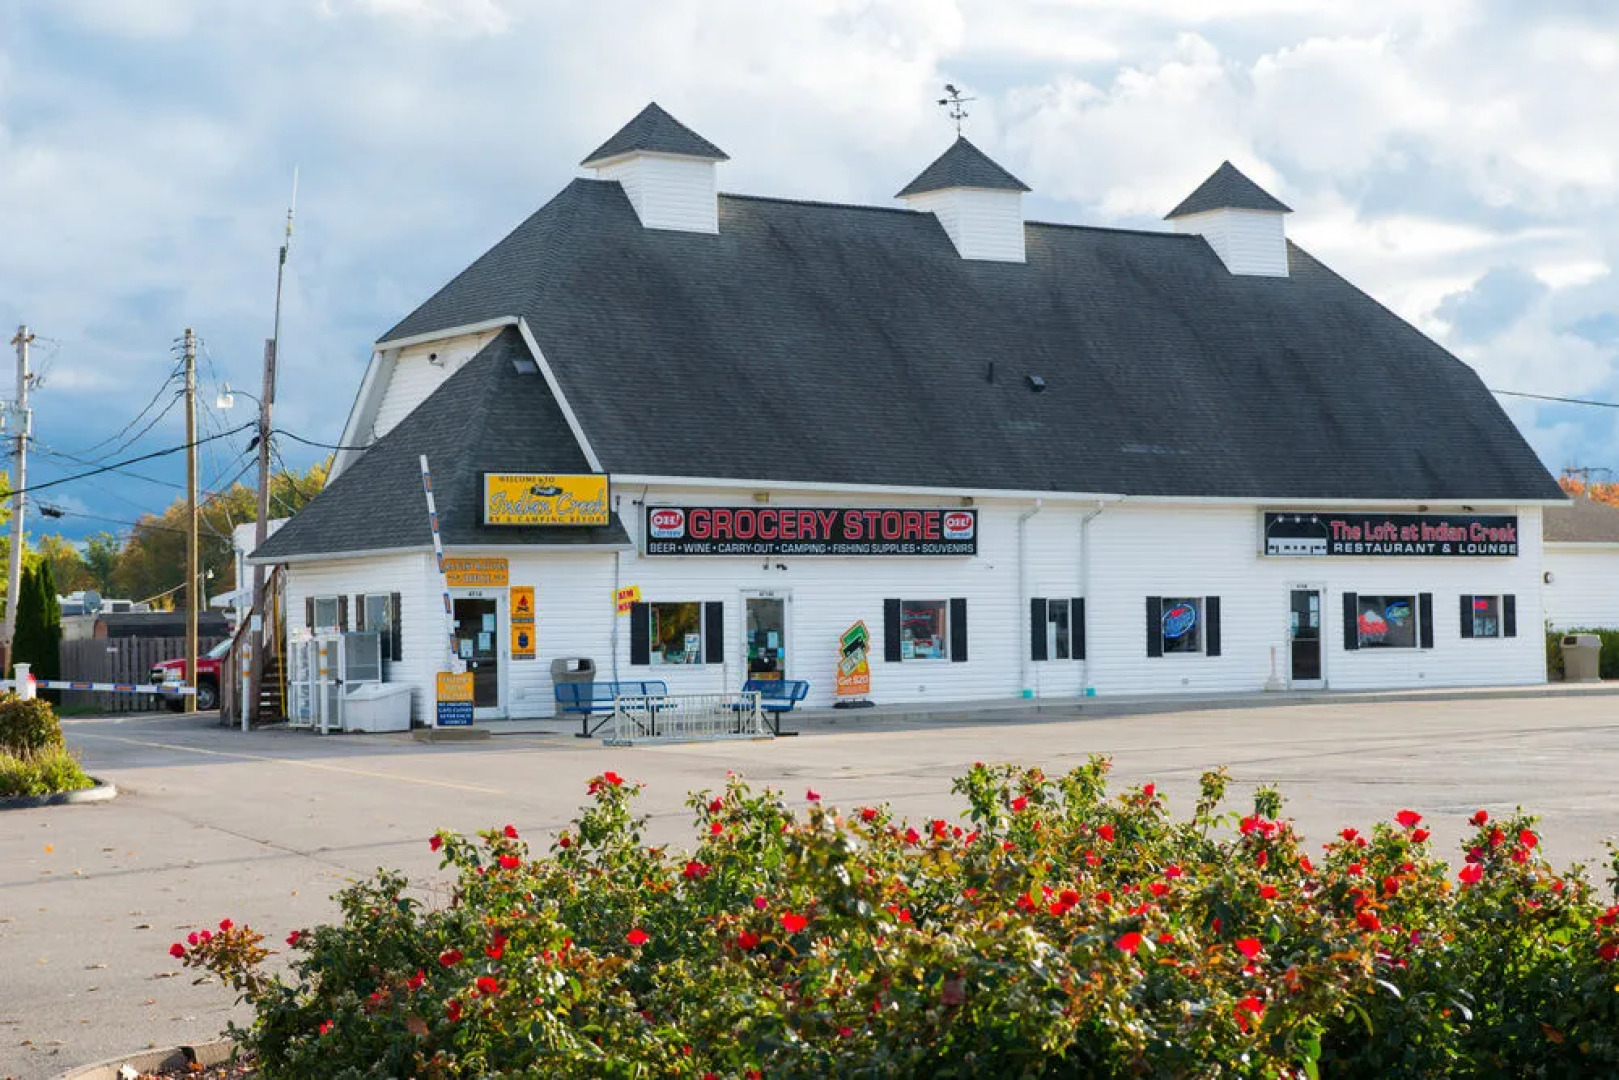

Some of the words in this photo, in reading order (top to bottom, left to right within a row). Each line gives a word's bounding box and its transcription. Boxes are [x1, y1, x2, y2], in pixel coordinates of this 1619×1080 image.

[489, 488, 552, 515] Indian
[556, 487, 607, 515] Creek
[689, 509, 839, 539] GROCERY
[843, 510, 940, 540] STORE
[1330, 520, 1361, 541] The
[1364, 521, 1398, 542] Loft
[1400, 524, 1419, 542] at
[1420, 522, 1467, 542] Indian
[1469, 522, 1516, 542] Creek
[650, 543, 676, 553] BEER
[683, 543, 711, 553] WINE
[718, 543, 774, 553] CARRY-OUT
[781, 543, 826, 553] CAMPING
[833, 544, 870, 553] FISHING
[870, 544, 916, 553] SUPPLIES
[922, 544, 974, 553] SOUVENIRS
[1333, 543, 1437, 553] RESTAURANT
[1442, 543, 1451, 553] &
[1458, 543, 1516, 554] LOUNGE
